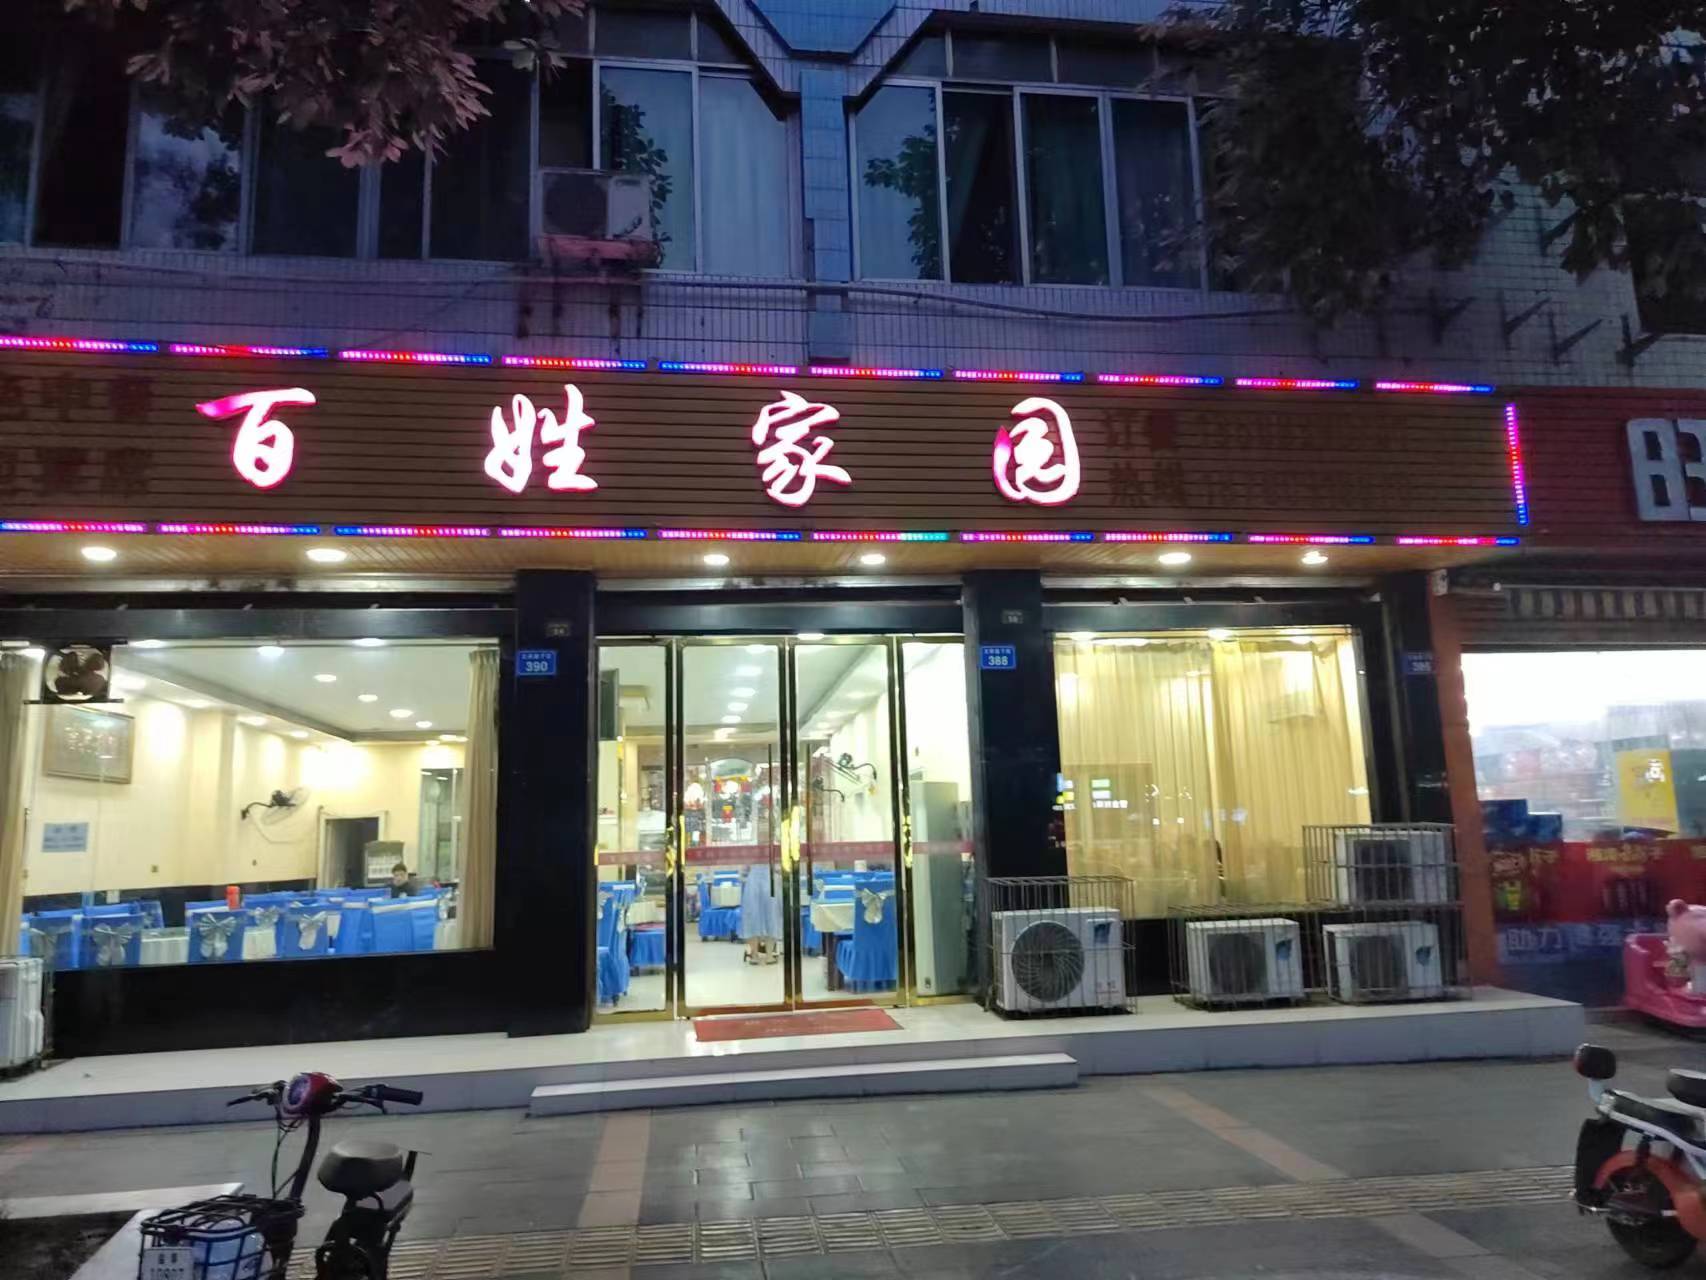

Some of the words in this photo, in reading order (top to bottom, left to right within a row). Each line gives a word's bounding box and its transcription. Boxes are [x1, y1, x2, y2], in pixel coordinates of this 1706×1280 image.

[196, 383, 1081, 507] 百姓家园
[525, 661, 548, 672] 390
[988, 656, 1008, 666] 388
